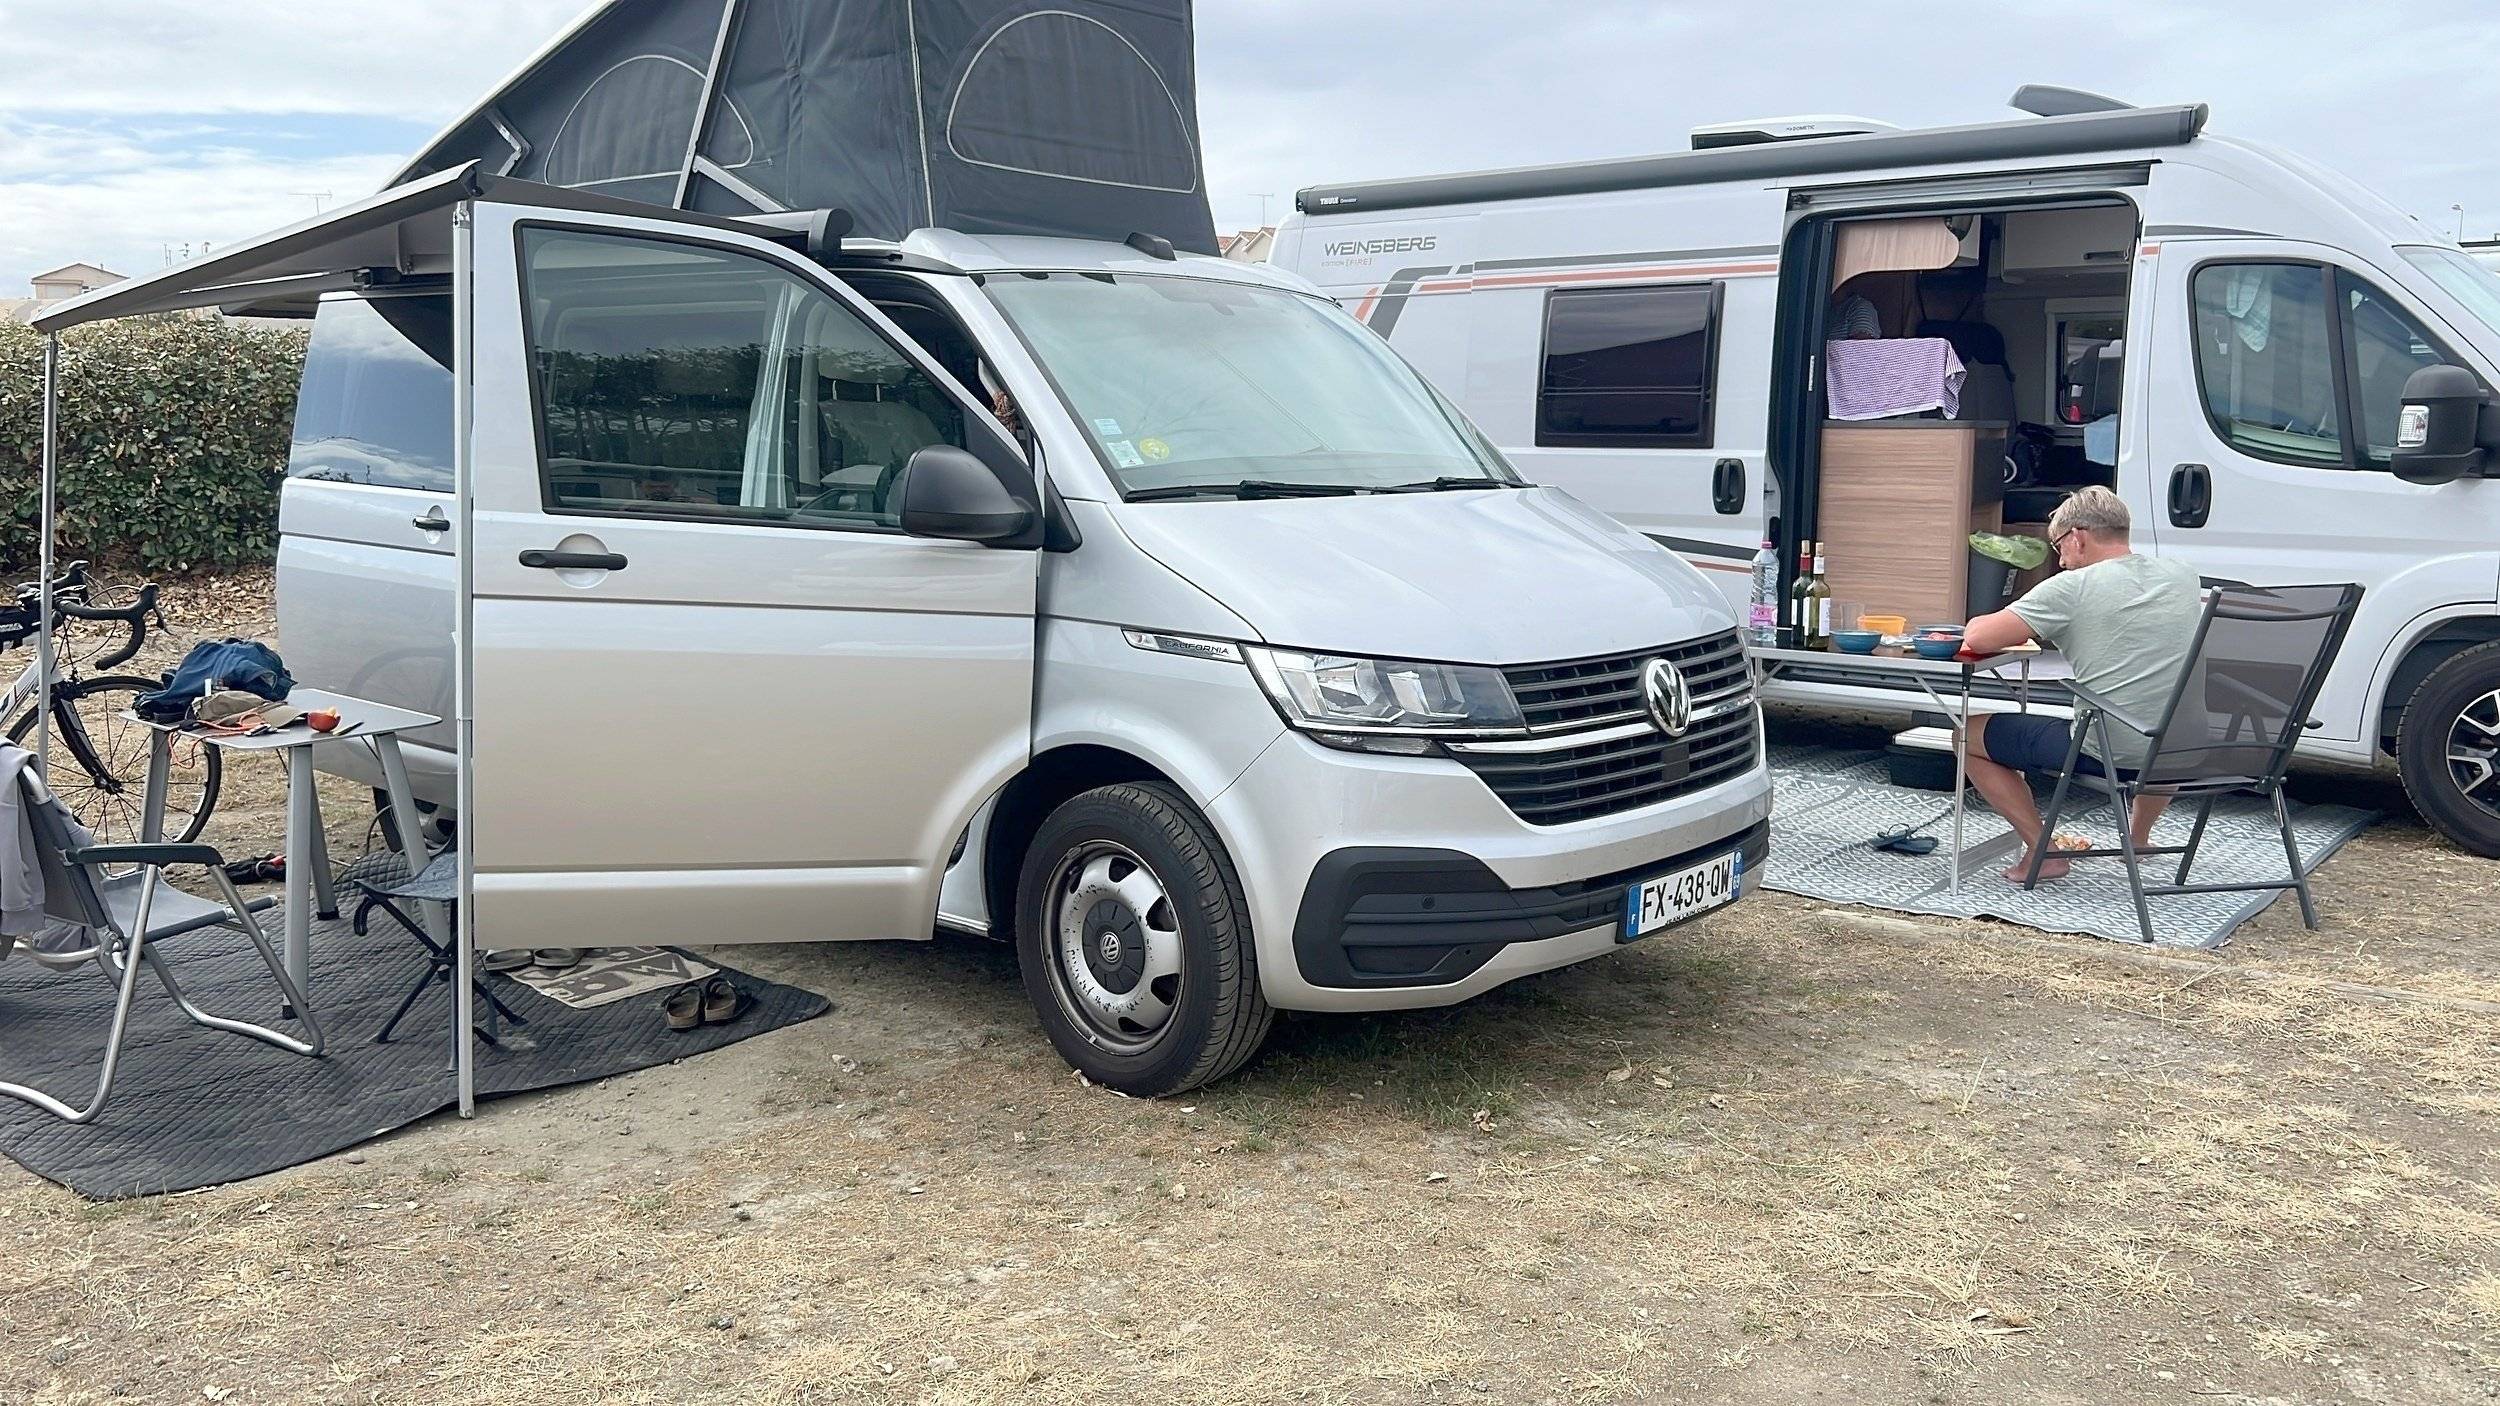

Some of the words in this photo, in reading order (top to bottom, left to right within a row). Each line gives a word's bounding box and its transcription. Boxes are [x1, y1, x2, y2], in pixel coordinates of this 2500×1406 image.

[1324, 236, 1437, 257] WEINSBERG
[1165, 640, 1230, 655] CALIFORNIA
[1641, 859, 1731, 924] FX-438-QW
[1631, 913, 1636, 925] F
